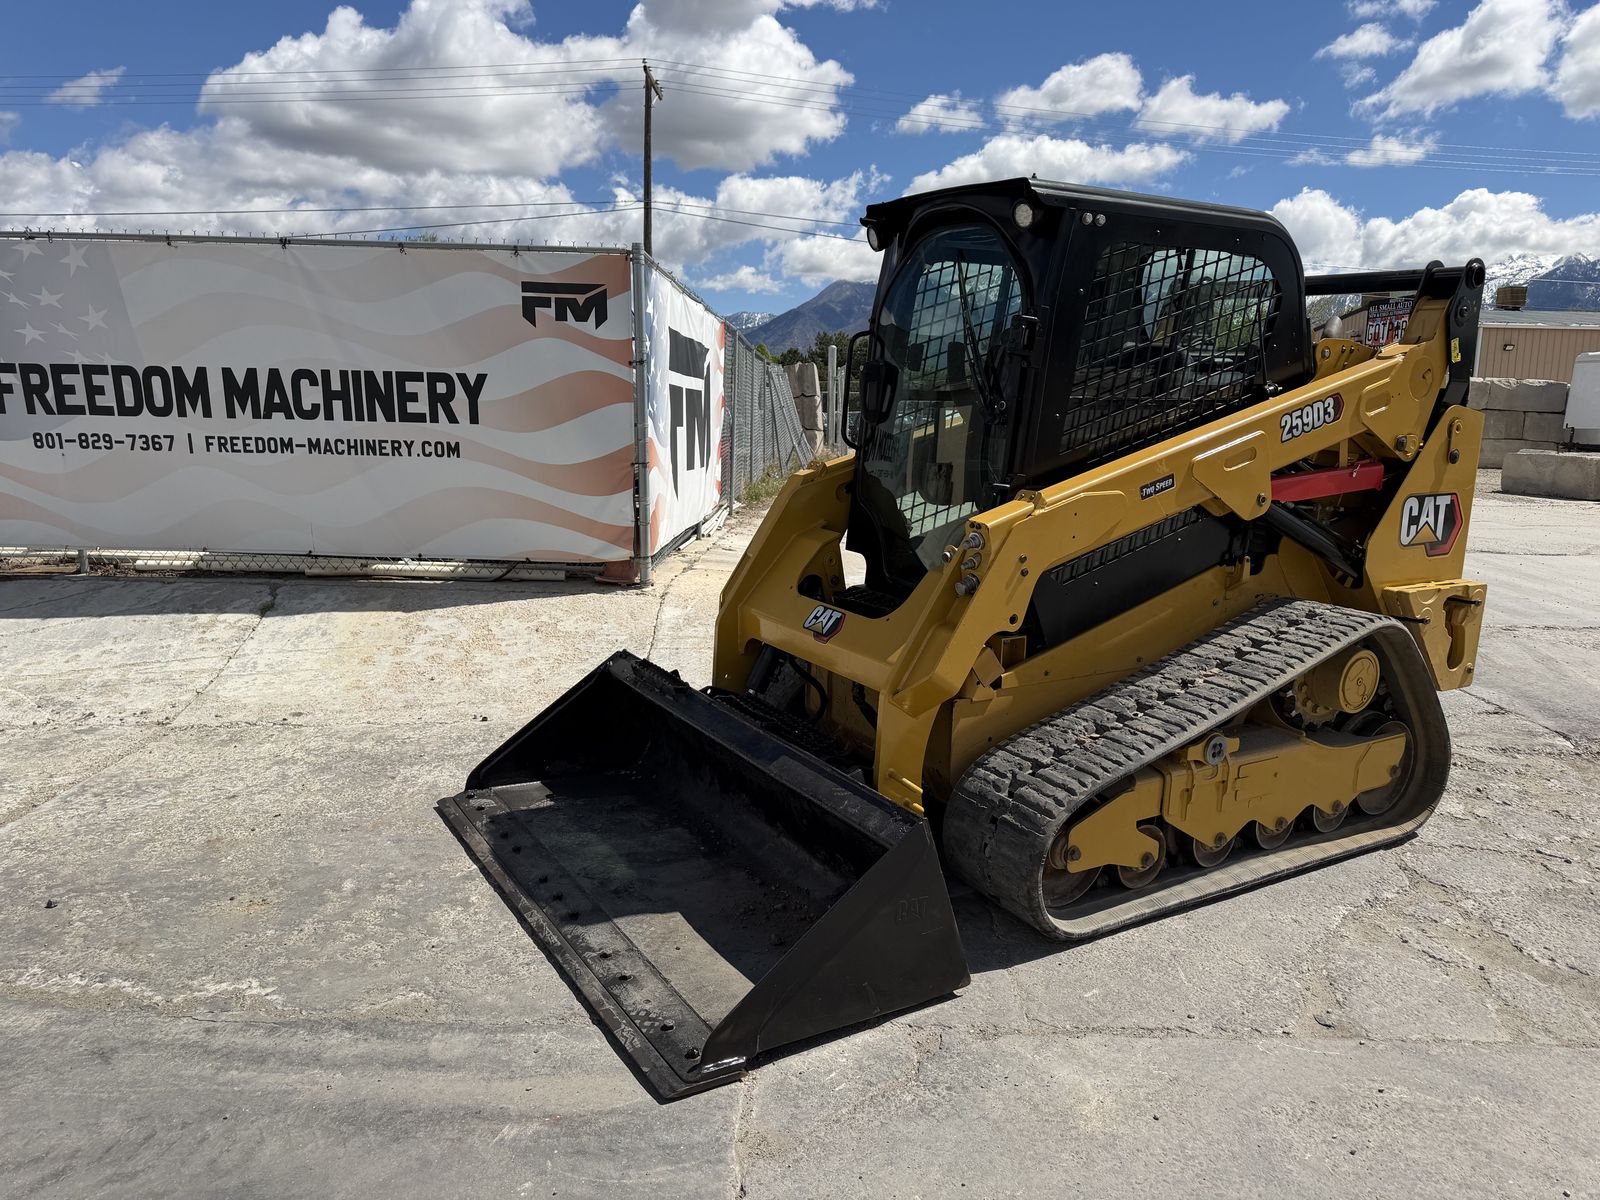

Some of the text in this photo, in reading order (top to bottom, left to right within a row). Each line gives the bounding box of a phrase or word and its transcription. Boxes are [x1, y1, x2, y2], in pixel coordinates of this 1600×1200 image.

[521, 281, 608, 329] FM
[0, 363, 487, 424] FREEDOM MACHINERY
[668, 326, 711, 500] FM
[1280, 396, 1336, 443] 259D3
[33, 432, 174, 452] 801-829-7367
[205, 435, 461, 459] FREEDOM-MACHINERY.COM
[1400, 494, 1452, 545] CAT
[803, 605, 842, 636] CAT
